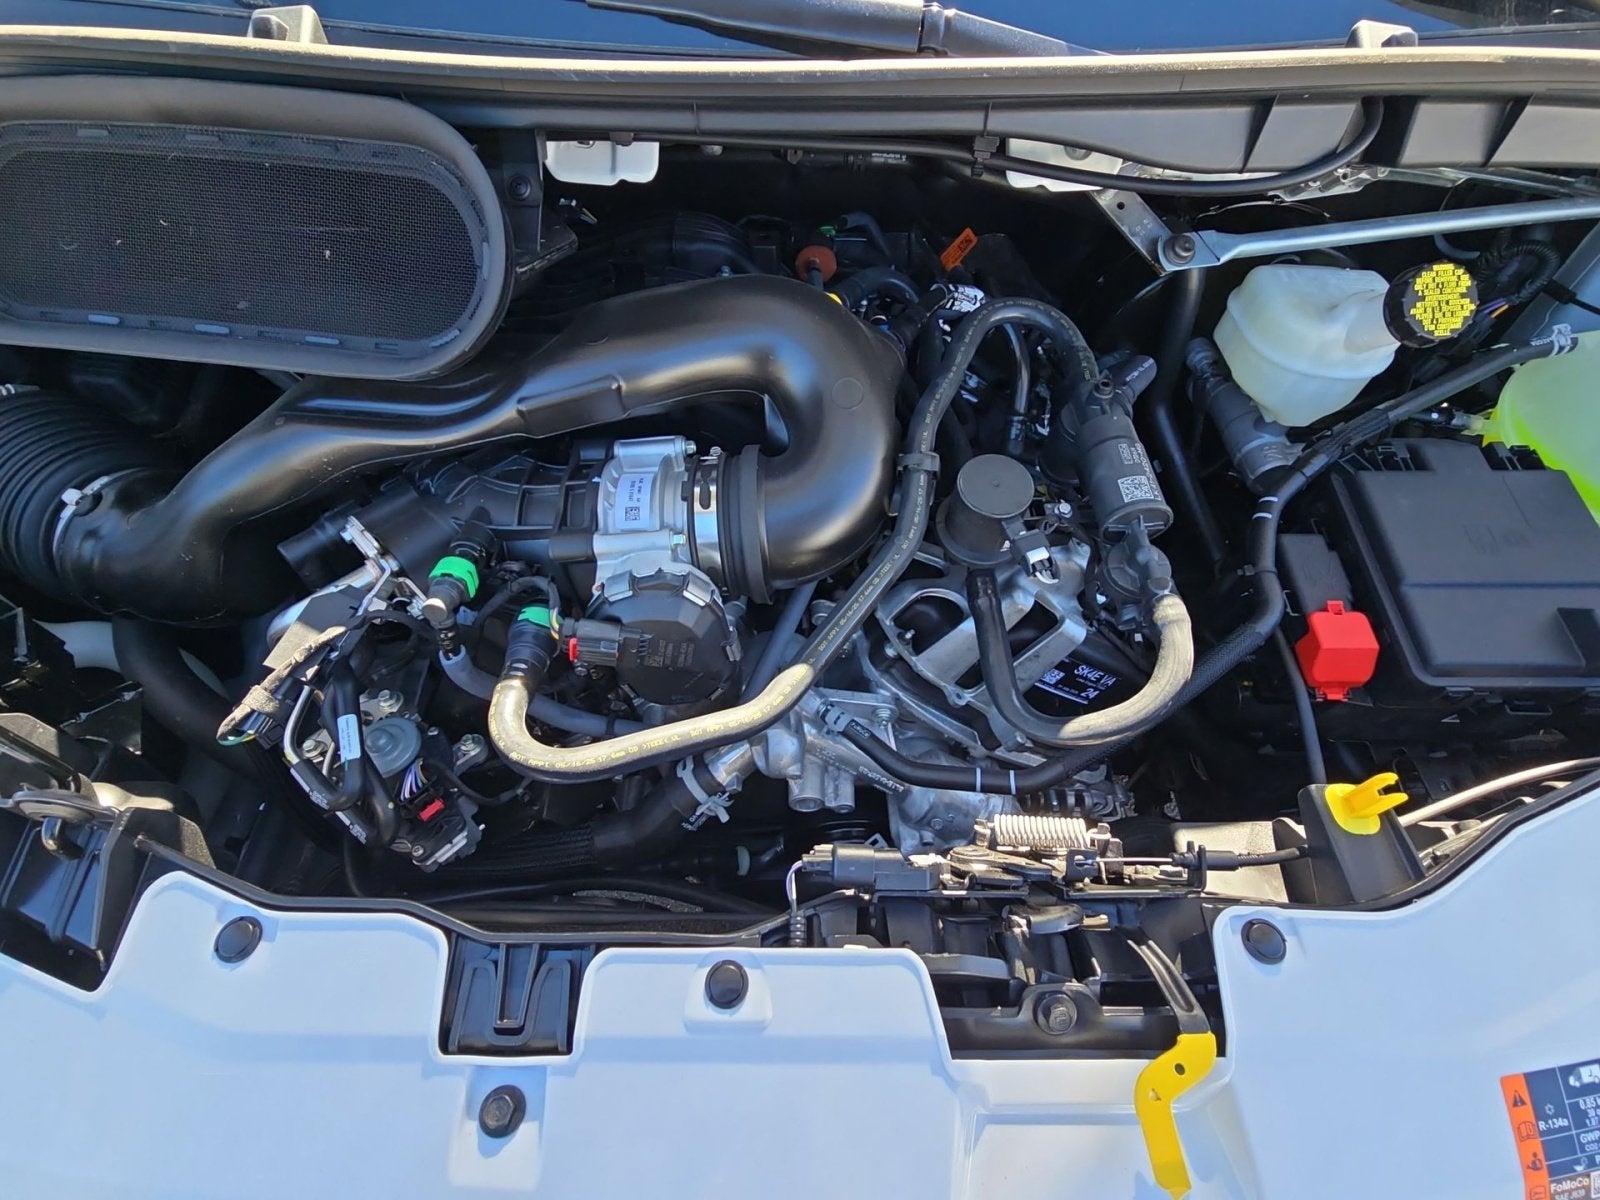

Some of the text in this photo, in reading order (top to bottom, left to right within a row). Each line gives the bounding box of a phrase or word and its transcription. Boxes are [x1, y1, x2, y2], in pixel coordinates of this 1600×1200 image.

[1080, 688, 1100, 699] 24
[1538, 1117, 1569, 1131] R-134a
[1580, 1130, 1600, 1144] GWP
[1550, 1177, 1590, 1194] FoMoCo
